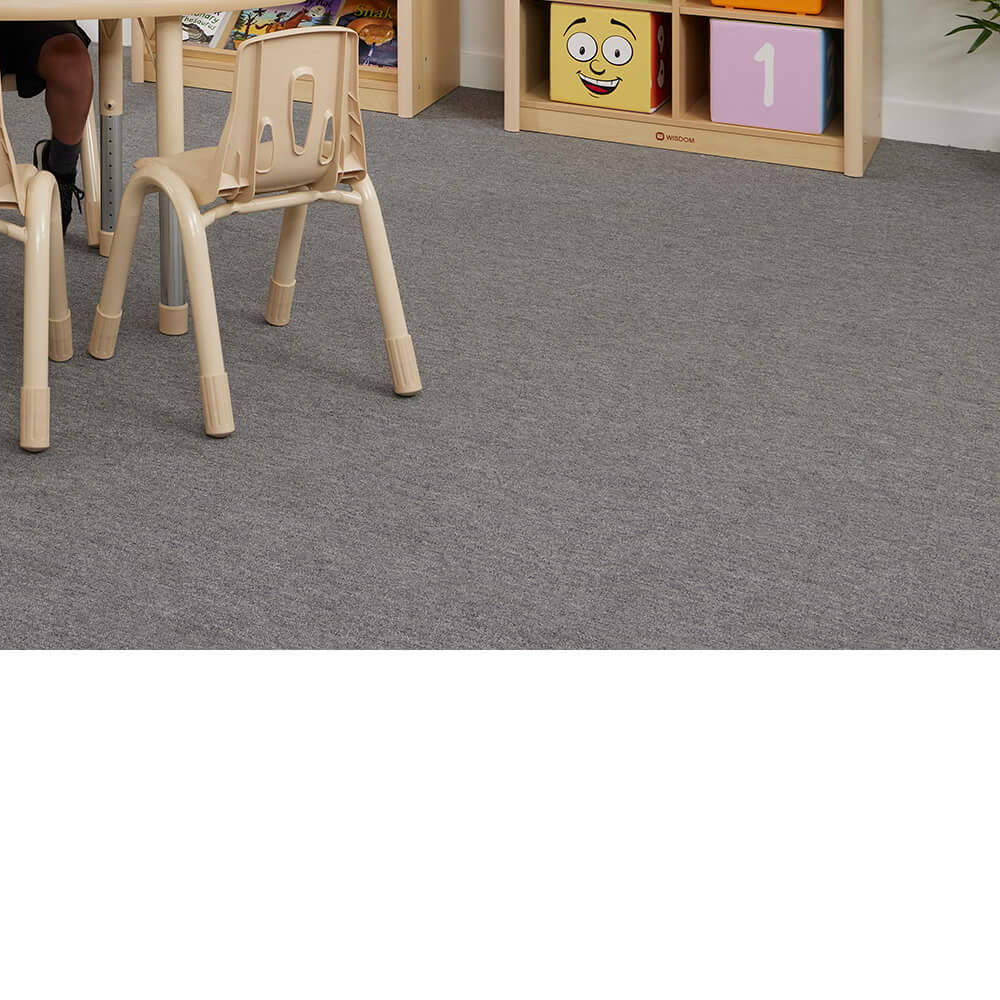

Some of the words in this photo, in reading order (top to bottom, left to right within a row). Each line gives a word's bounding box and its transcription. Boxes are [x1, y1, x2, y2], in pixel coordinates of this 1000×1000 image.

[354, 4, 393, 18] Snak
[753, 42, 775, 107] 1
[666, 135, 695, 143] WISDOM
